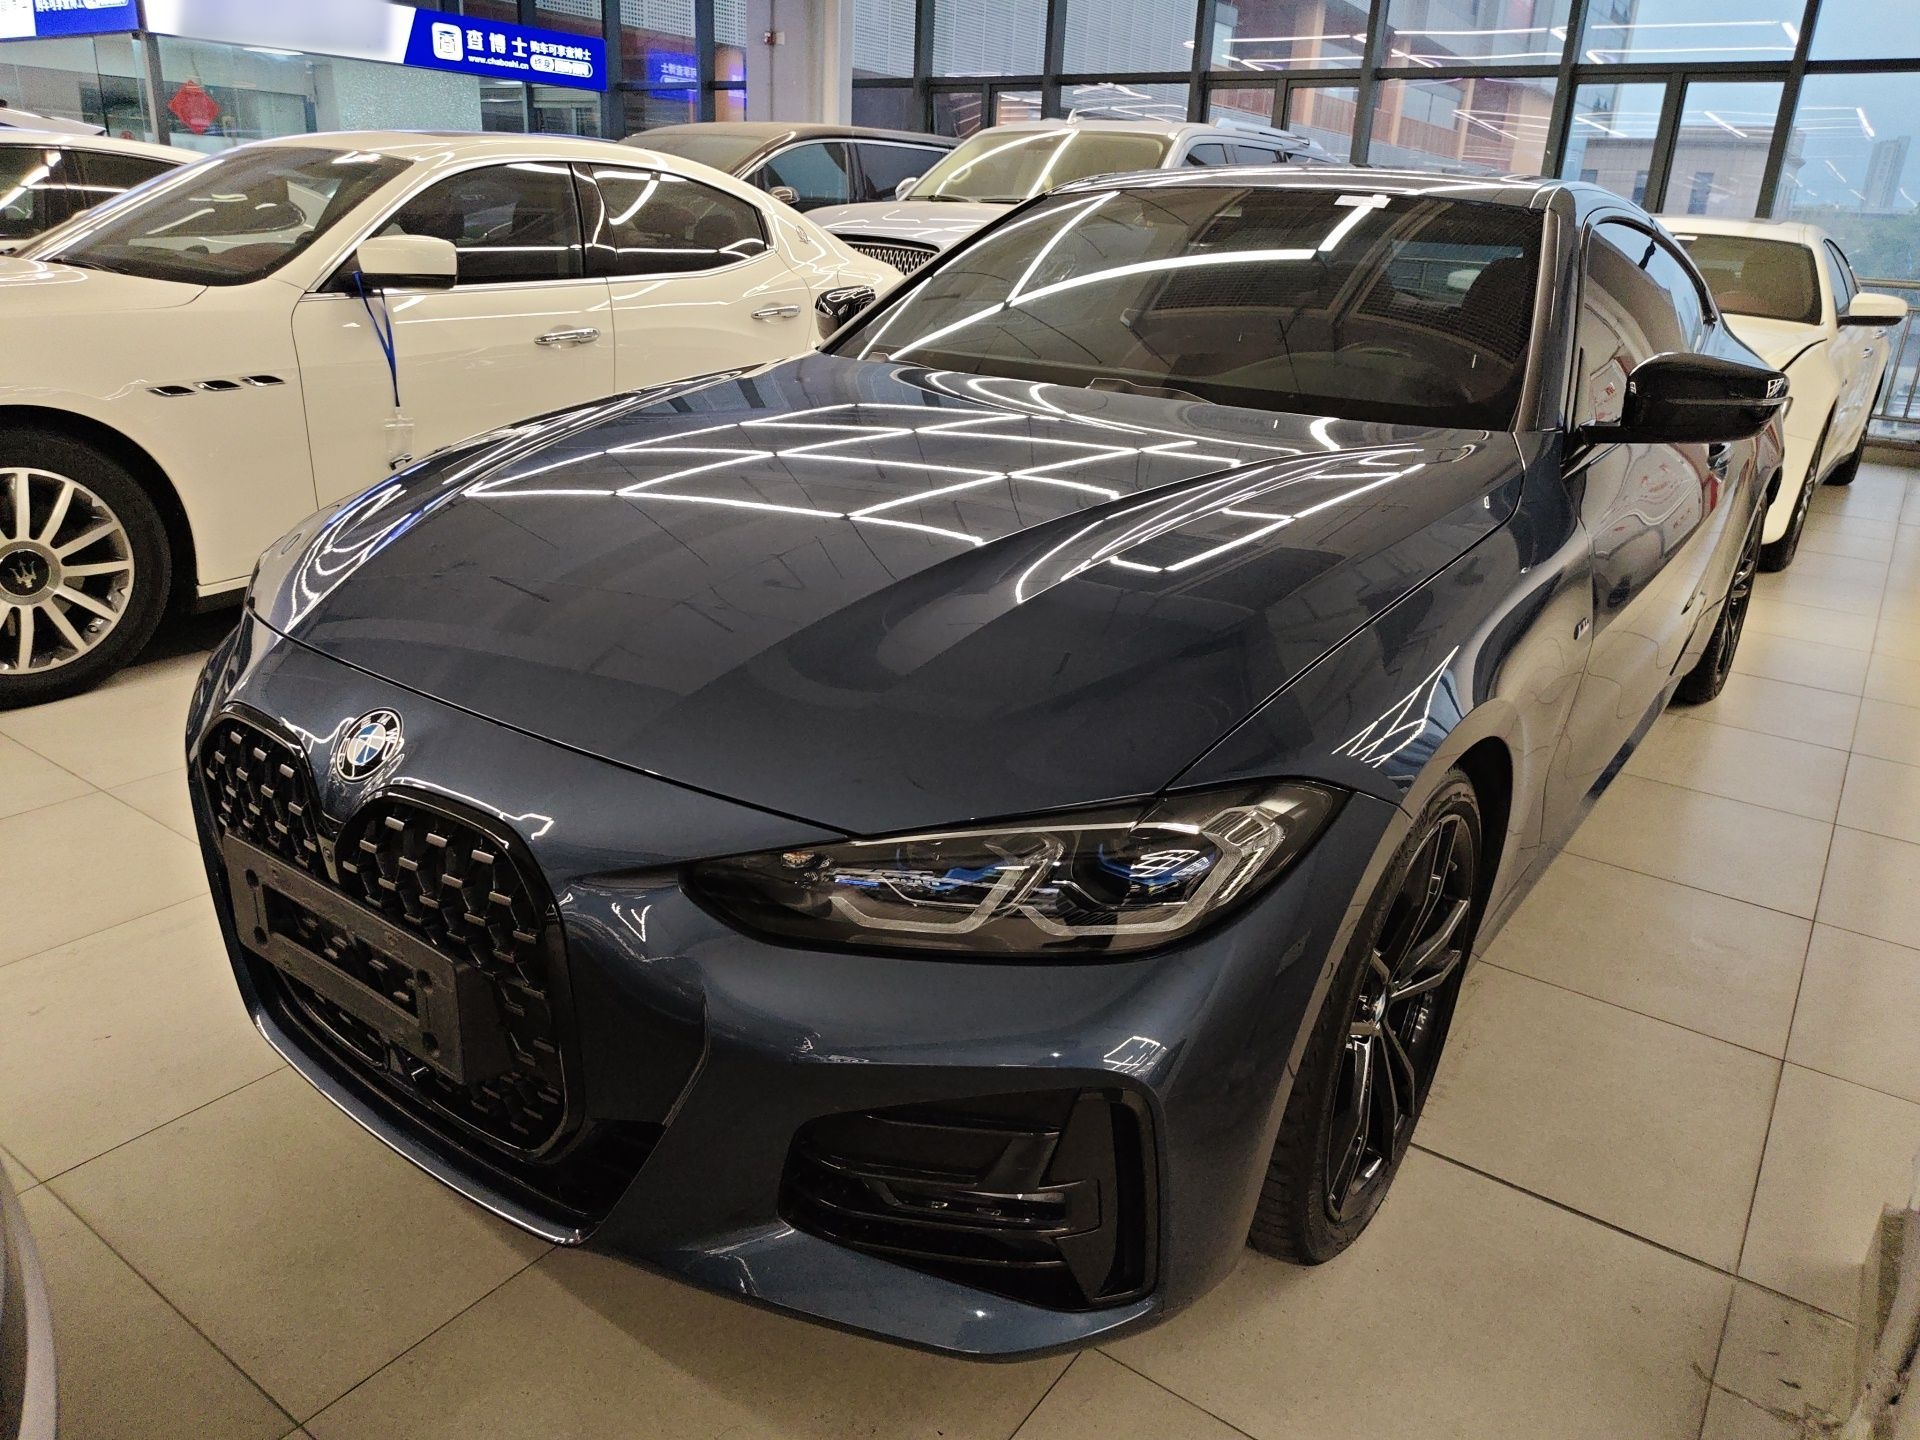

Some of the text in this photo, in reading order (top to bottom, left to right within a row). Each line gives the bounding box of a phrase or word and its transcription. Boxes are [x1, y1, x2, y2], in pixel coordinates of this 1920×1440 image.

[466, 29, 528, 58] 查博士
[467, 55, 529, 70] www.chaboshi.cn
[360, 713, 399, 742] BMW
